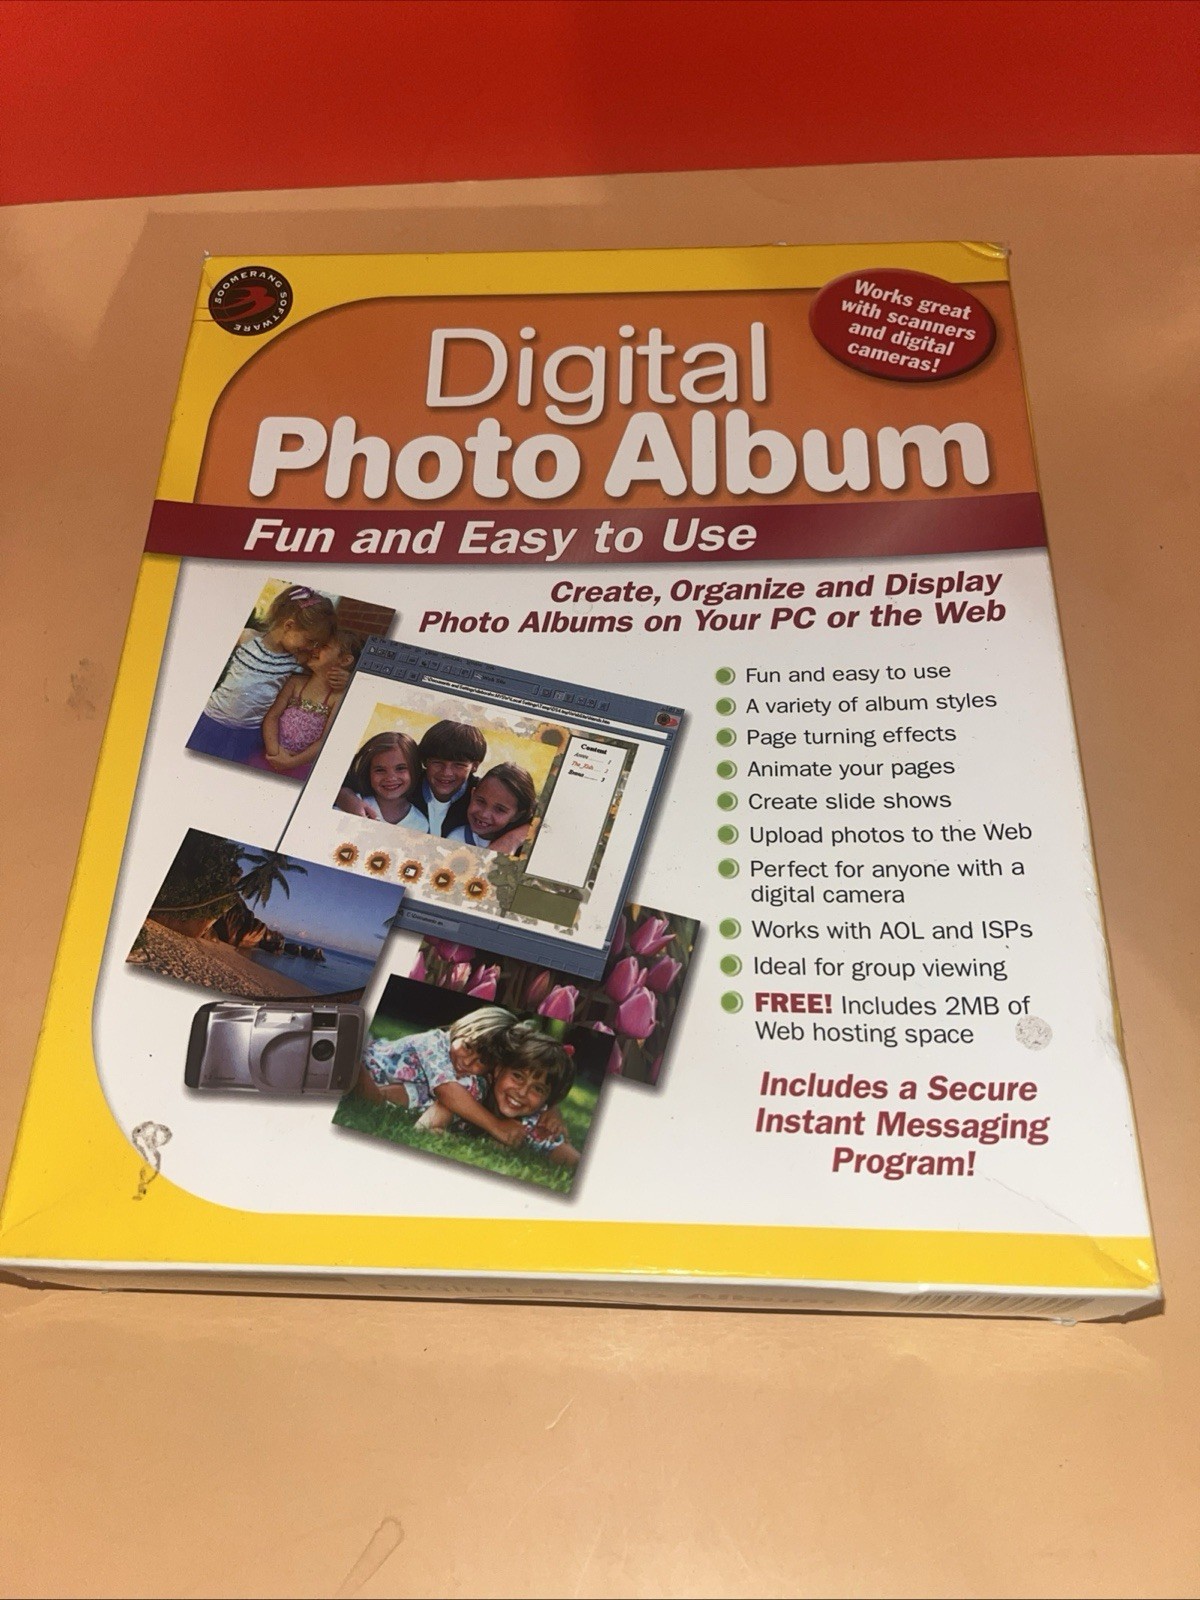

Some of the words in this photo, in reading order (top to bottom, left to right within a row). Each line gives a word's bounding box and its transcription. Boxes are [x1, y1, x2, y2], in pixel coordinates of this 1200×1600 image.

[215, 271, 283, 304] BOOMERANG
[855, 279, 913, 307] Works
[917, 300, 972, 320] great
[234, 292, 287, 332] SOFTWARE
[841, 299, 882, 320] with
[887, 311, 976, 341] scanners
[848, 322, 887, 341] and
[890, 331, 955, 356] digital
[426, 321, 767, 425] Digital
[847, 343, 940, 373] cameras!
[248, 415, 582, 500] Photo
[604, 409, 991, 498] Album
[244, 518, 335, 554] Fun
[350, 521, 444, 554] and
[458, 520, 578, 562] Easy
[594, 520, 644, 554] to
[662, 518, 757, 553] Use
[550, 579, 662, 606] Create,
[670, 576, 805, 605] Organize
[816, 574, 875, 598] and
[885, 570, 1003, 597] Display
[419, 611, 509, 634] Photo
[519, 610, 633, 633] Albums
[644, 614, 682, 633] on
[696, 609, 761, 631] Your
[771, 606, 816, 630] PC
[827, 608, 860, 627] or
[870, 604, 923, 626] the
[935, 599, 1007, 624] Web
[746, 667, 781, 683] Fun
[789, 667, 825, 683] and
[832, 667, 880, 684] easy
[886, 665, 906, 680] to
[914, 665, 951, 680] use
[746, 698, 760, 714] A
[765, 697, 831, 716] variety
[838, 696, 859, 713] of
[865, 695, 928, 712] album
[936, 692, 997, 710] styles
[581, 744, 607, 754] Content
[747, 729, 796, 749] Page
[803, 728, 877, 748] turning
[883, 726, 957, 743] effects
[747, 761, 832, 777] Animate
[838, 761, 883, 780] your
[891, 759, 955, 778] pages
[748, 793, 818, 810] Create
[825, 792, 875, 810] slide
[883, 792, 952, 809] shows
[750, 826, 823, 846] Upload
[831, 826, 905, 846] photos
[912, 827, 933, 843] to
[940, 825, 976, 842] the
[983, 823, 1032, 841] Web
[750, 860, 828, 878] Perfect
[834, 859, 864, 878] for
[872, 861, 950, 881] anyone
[957, 859, 1003, 877] with
[1011, 860, 1025, 876] a
[750, 885, 815, 907] digital
[822, 887, 905, 903] camera
[751, 920, 820, 939] Works
[826, 921, 871, 940] with
[879, 921, 925, 940] AOL
[932, 921, 973, 940] and
[982, 920, 1033, 939] ISPs
[754, 957, 806, 975] Ideal
[814, 957, 844, 976] for
[851, 960, 916, 981] group
[922, 958, 1008, 981] viewing
[755, 992, 833, 1014] FREE!
[842, 995, 937, 1016] Includes
[945, 996, 1000, 1016] 2MB
[1008, 995, 1030, 1015] of
[755, 1021, 804, 1040] Web
[812, 1022, 898, 1047] hosting
[904, 1026, 974, 1047] space
[760, 1071, 888, 1099] Includes
[899, 1080, 917, 1100] a
[927, 1075, 1038, 1101] Secure
[755, 1107, 865, 1136] Instant
[876, 1111, 1051, 1145] Messaging
[832, 1146, 977, 1180] Program!
